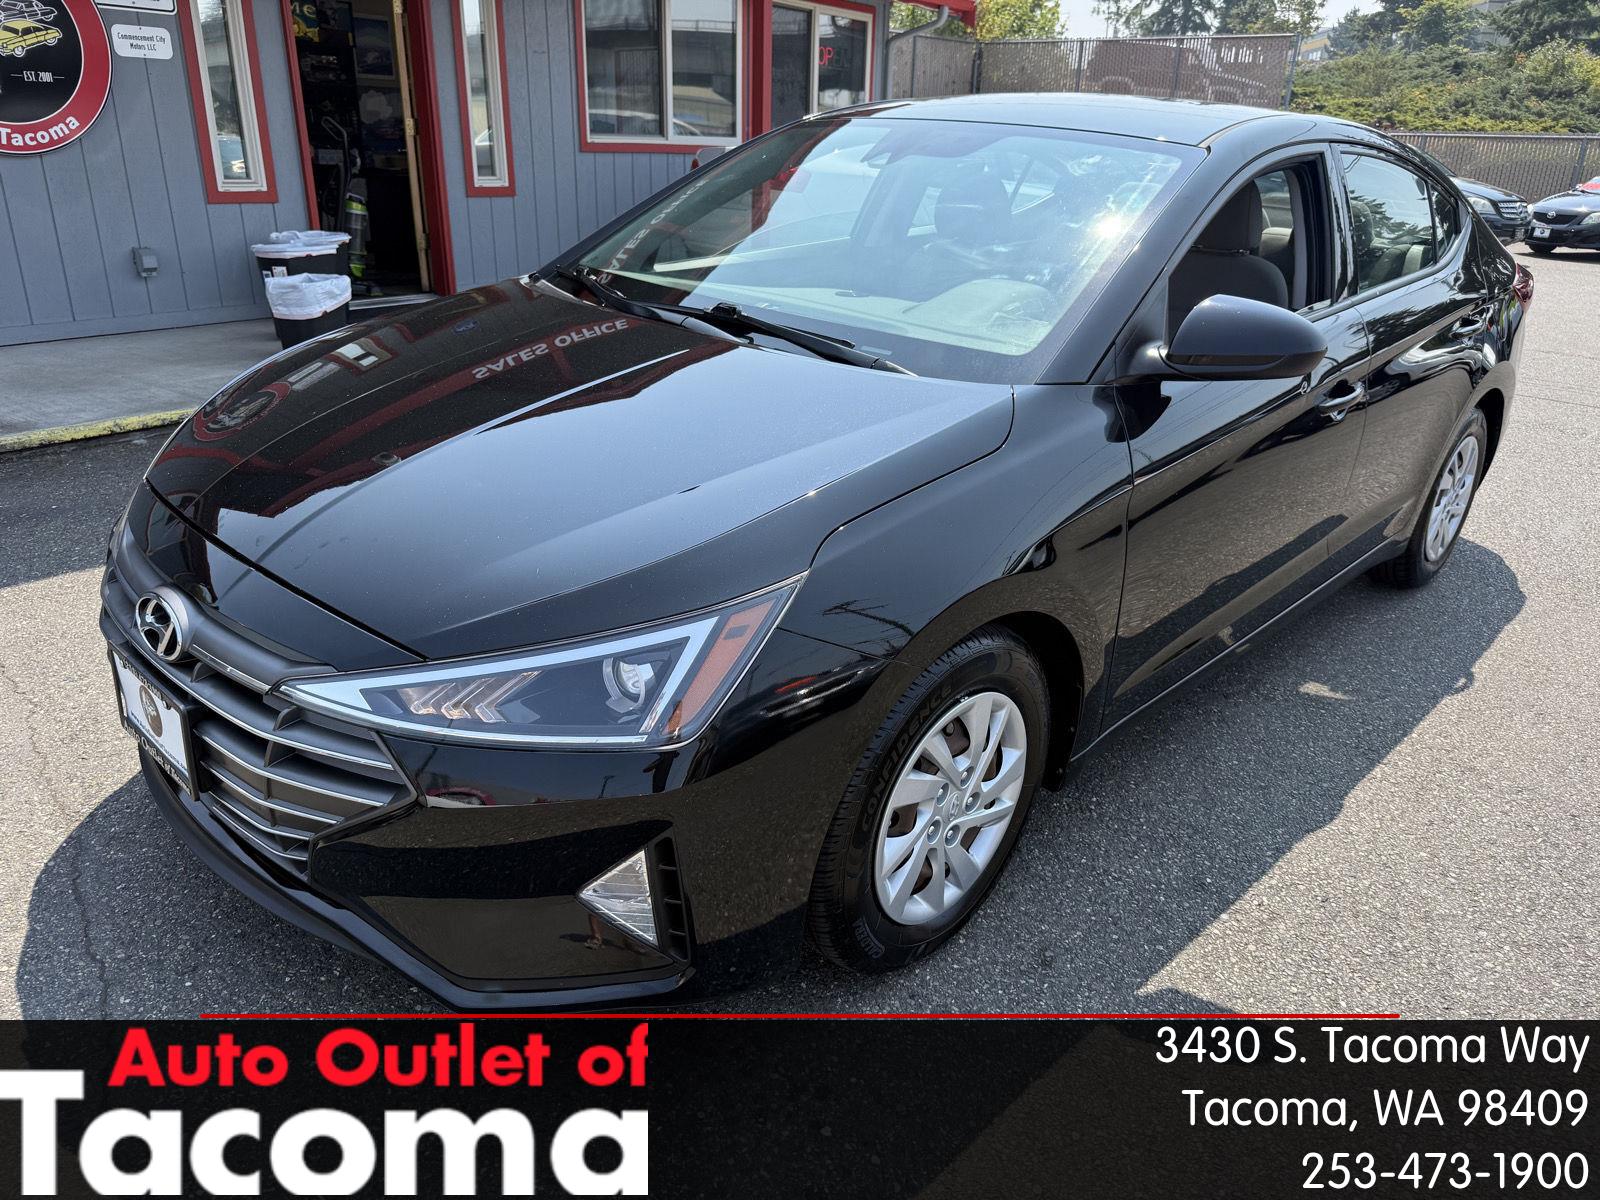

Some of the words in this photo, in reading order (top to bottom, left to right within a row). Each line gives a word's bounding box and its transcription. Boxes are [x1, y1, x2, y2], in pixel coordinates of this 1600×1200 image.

[117, 32, 155, 42] Commencement
[155, 35, 166, 44] City
[129, 42, 147, 51] Motors
[147, 44, 157, 52] LLC
[37, 71, 54, 83] 2001
[0, 116, 80, 146] Tacoma
[861, 685, 953, 832] CONFIDENCE
